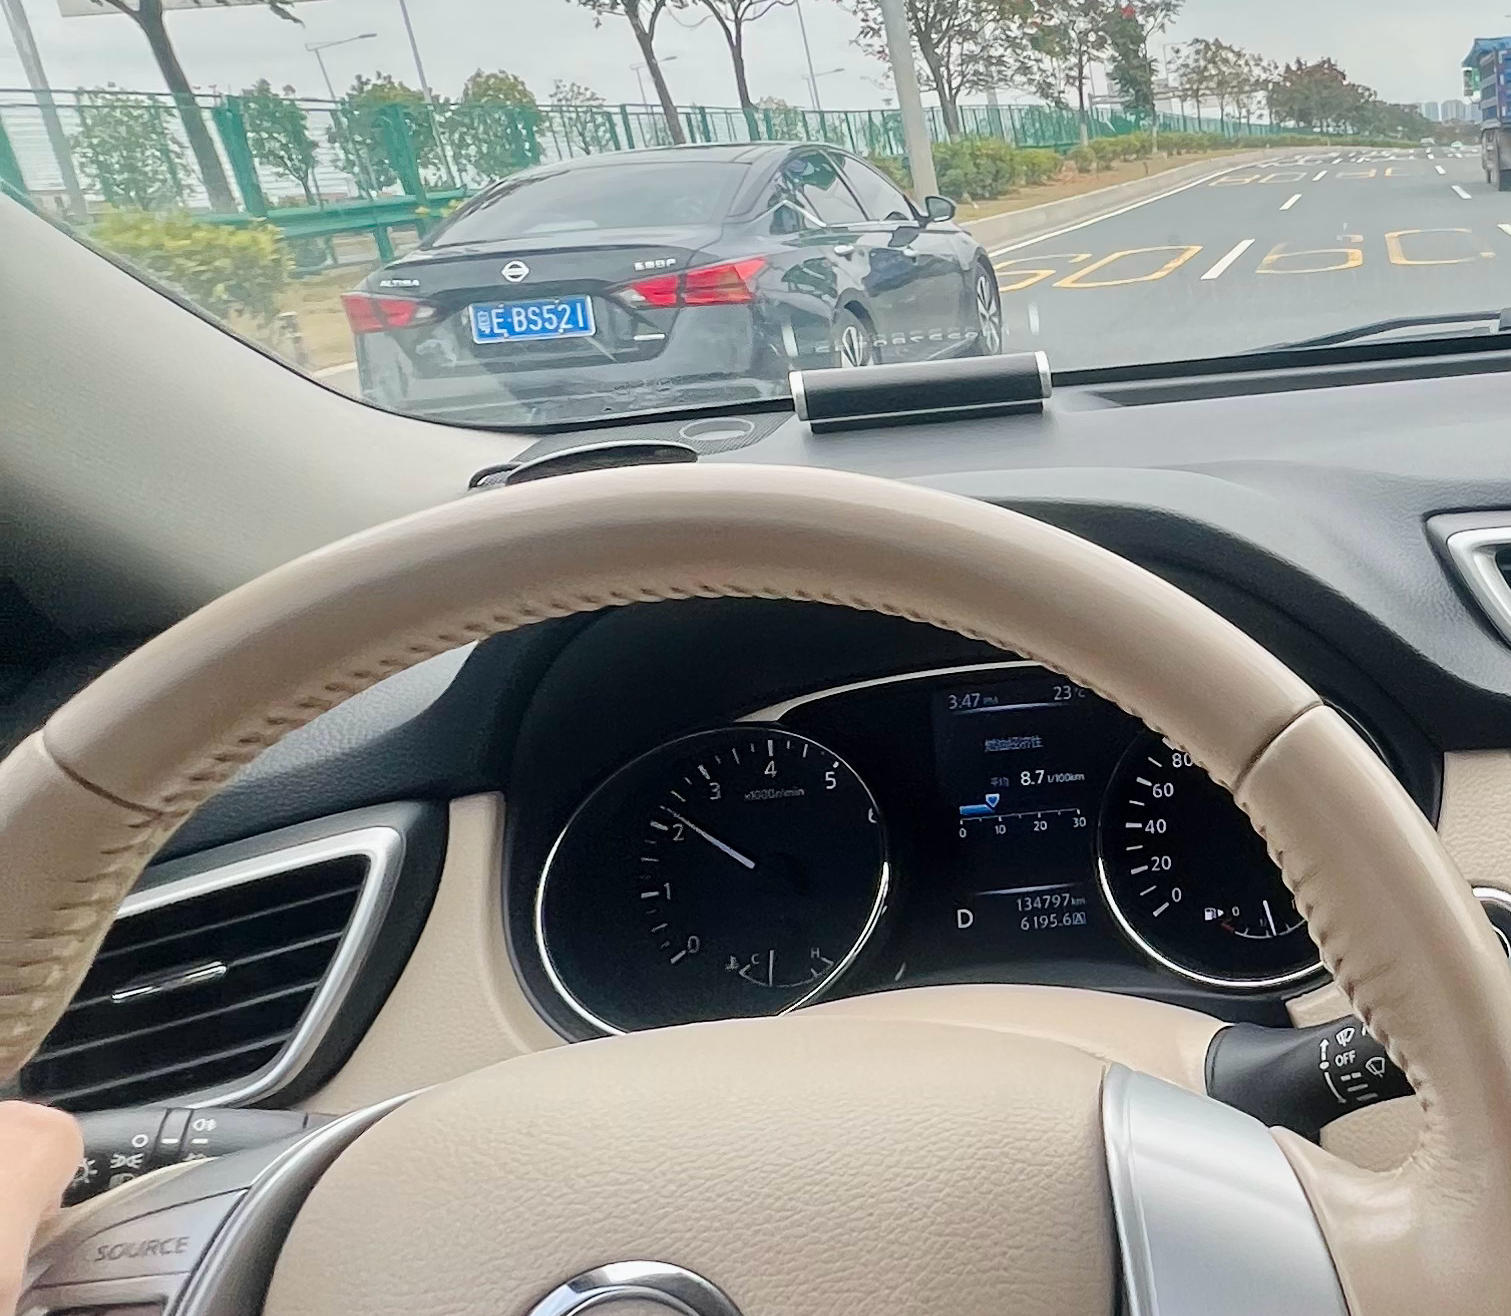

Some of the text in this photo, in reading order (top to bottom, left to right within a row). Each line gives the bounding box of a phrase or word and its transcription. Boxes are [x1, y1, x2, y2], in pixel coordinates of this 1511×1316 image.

[948, 692, 981, 710] 3:47
[1053, 685, 1072, 701] 23
[764, 760, 777, 777] 4
[1172, 752, 1193, 768] 80
[825, 771, 837, 789] 5
[1020, 769, 1045, 786] 8.7
[709, 782, 722, 800] 3
[1152, 782, 1174, 798] 60
[672, 824, 685, 841] 2
[959, 817, 1087, 838] 0 10 20 30
[1145, 819, 1167, 834] 40
[1151, 855, 1172, 871] 20
[664, 882, 671, 900] 1
[1171, 887, 1182, 902] 0
[1017, 893, 1086, 912] 134797 km
[957, 909, 974, 929] D
[1231, 906, 1240, 917] 0
[1020, 912, 1072, 930] 6195.6
[687, 936, 700, 954] 0
[810, 947, 820, 958] H
[751, 953, 760, 964] C
[1335, 1049, 1356, 1067] OFF
[95, 1235, 190, 1263] SOURCE
